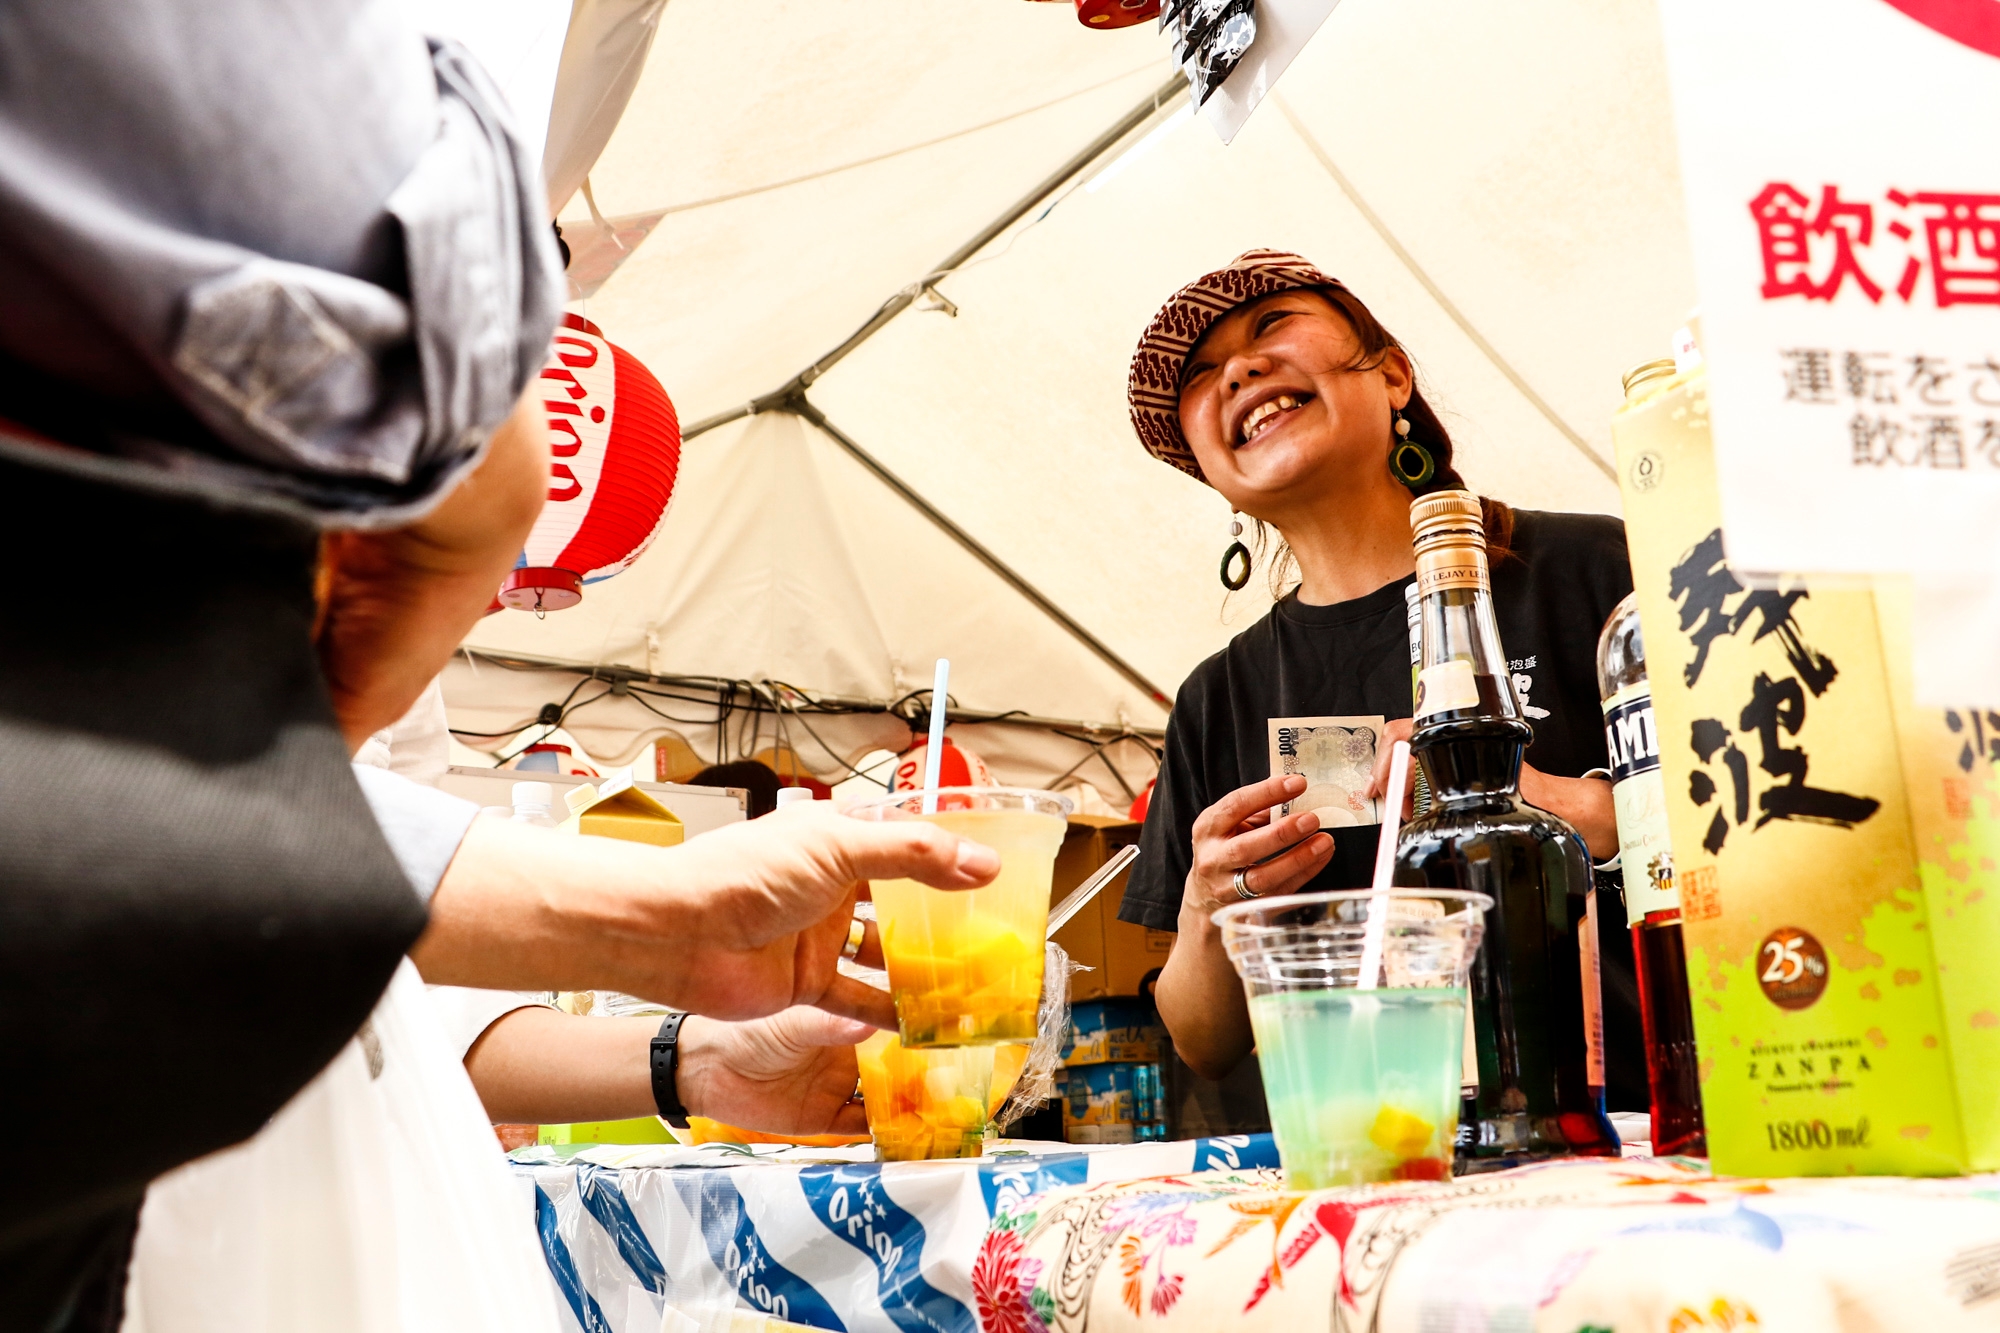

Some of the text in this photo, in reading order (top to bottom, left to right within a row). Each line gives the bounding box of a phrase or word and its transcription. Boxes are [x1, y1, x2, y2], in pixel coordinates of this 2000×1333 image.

[1749, 182, 2000, 307] 飲酒
[1433, 570, 1466, 581] LEJAY
[1278, 727, 1291, 757] 1000
[1747, 1055, 1872, 1079] ZANPA
[829, 1186, 903, 1284] Orion
[724, 1239, 789, 1321] Orion
